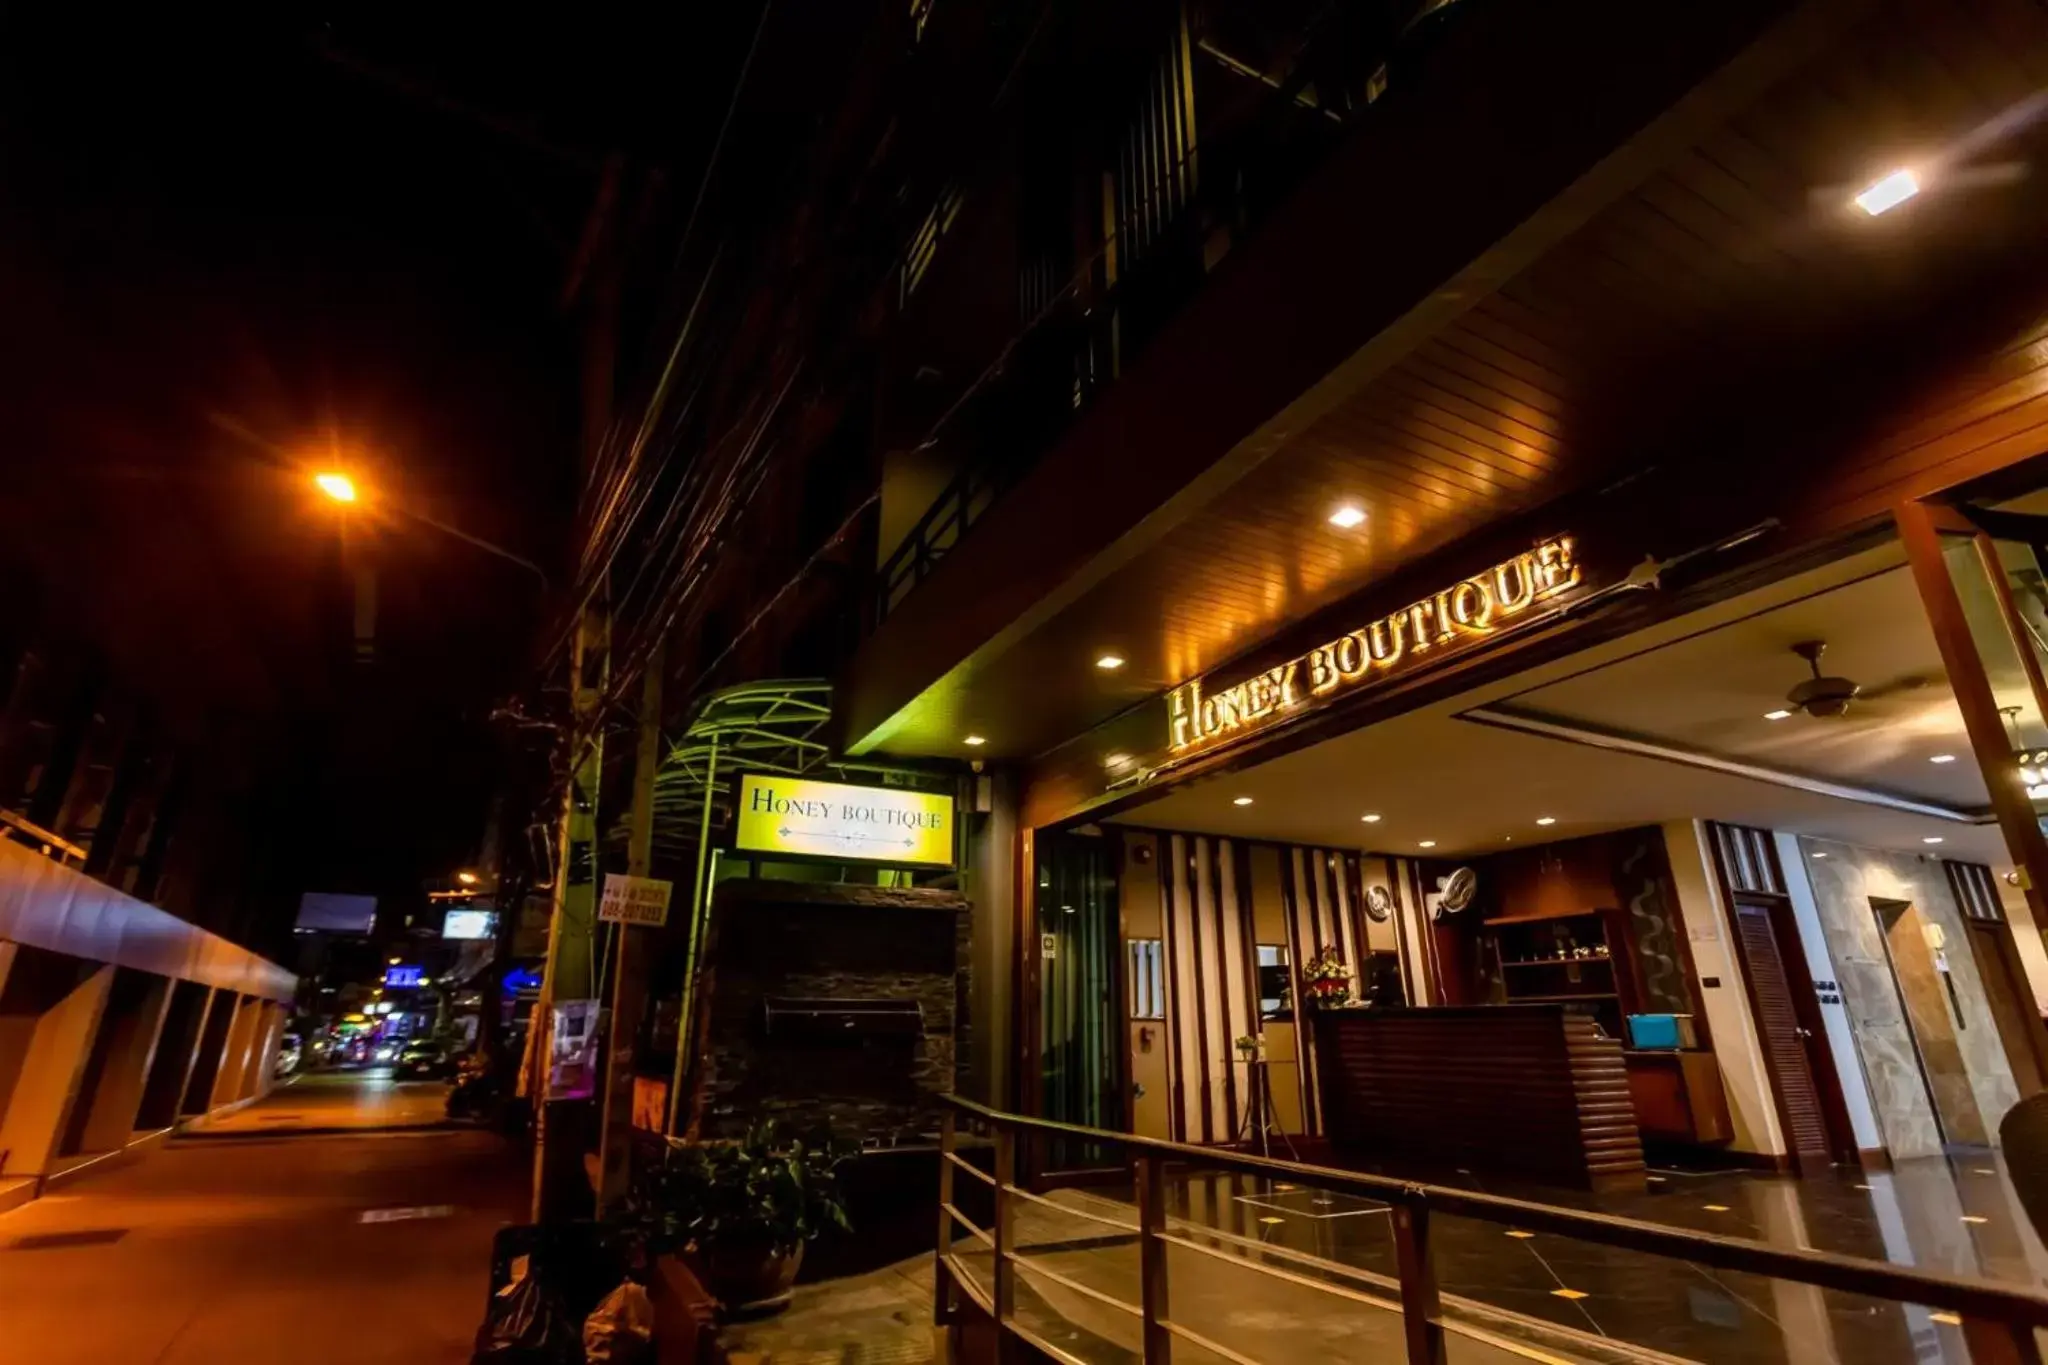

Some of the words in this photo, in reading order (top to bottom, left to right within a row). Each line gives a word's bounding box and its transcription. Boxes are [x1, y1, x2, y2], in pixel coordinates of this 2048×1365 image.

[1168, 662, 1297, 752] HONEY
[1305, 535, 1581, 696] BOUTIQUE
[752, 787, 832, 818] HONEY
[842, 804, 943, 830] BOUTIQUE
